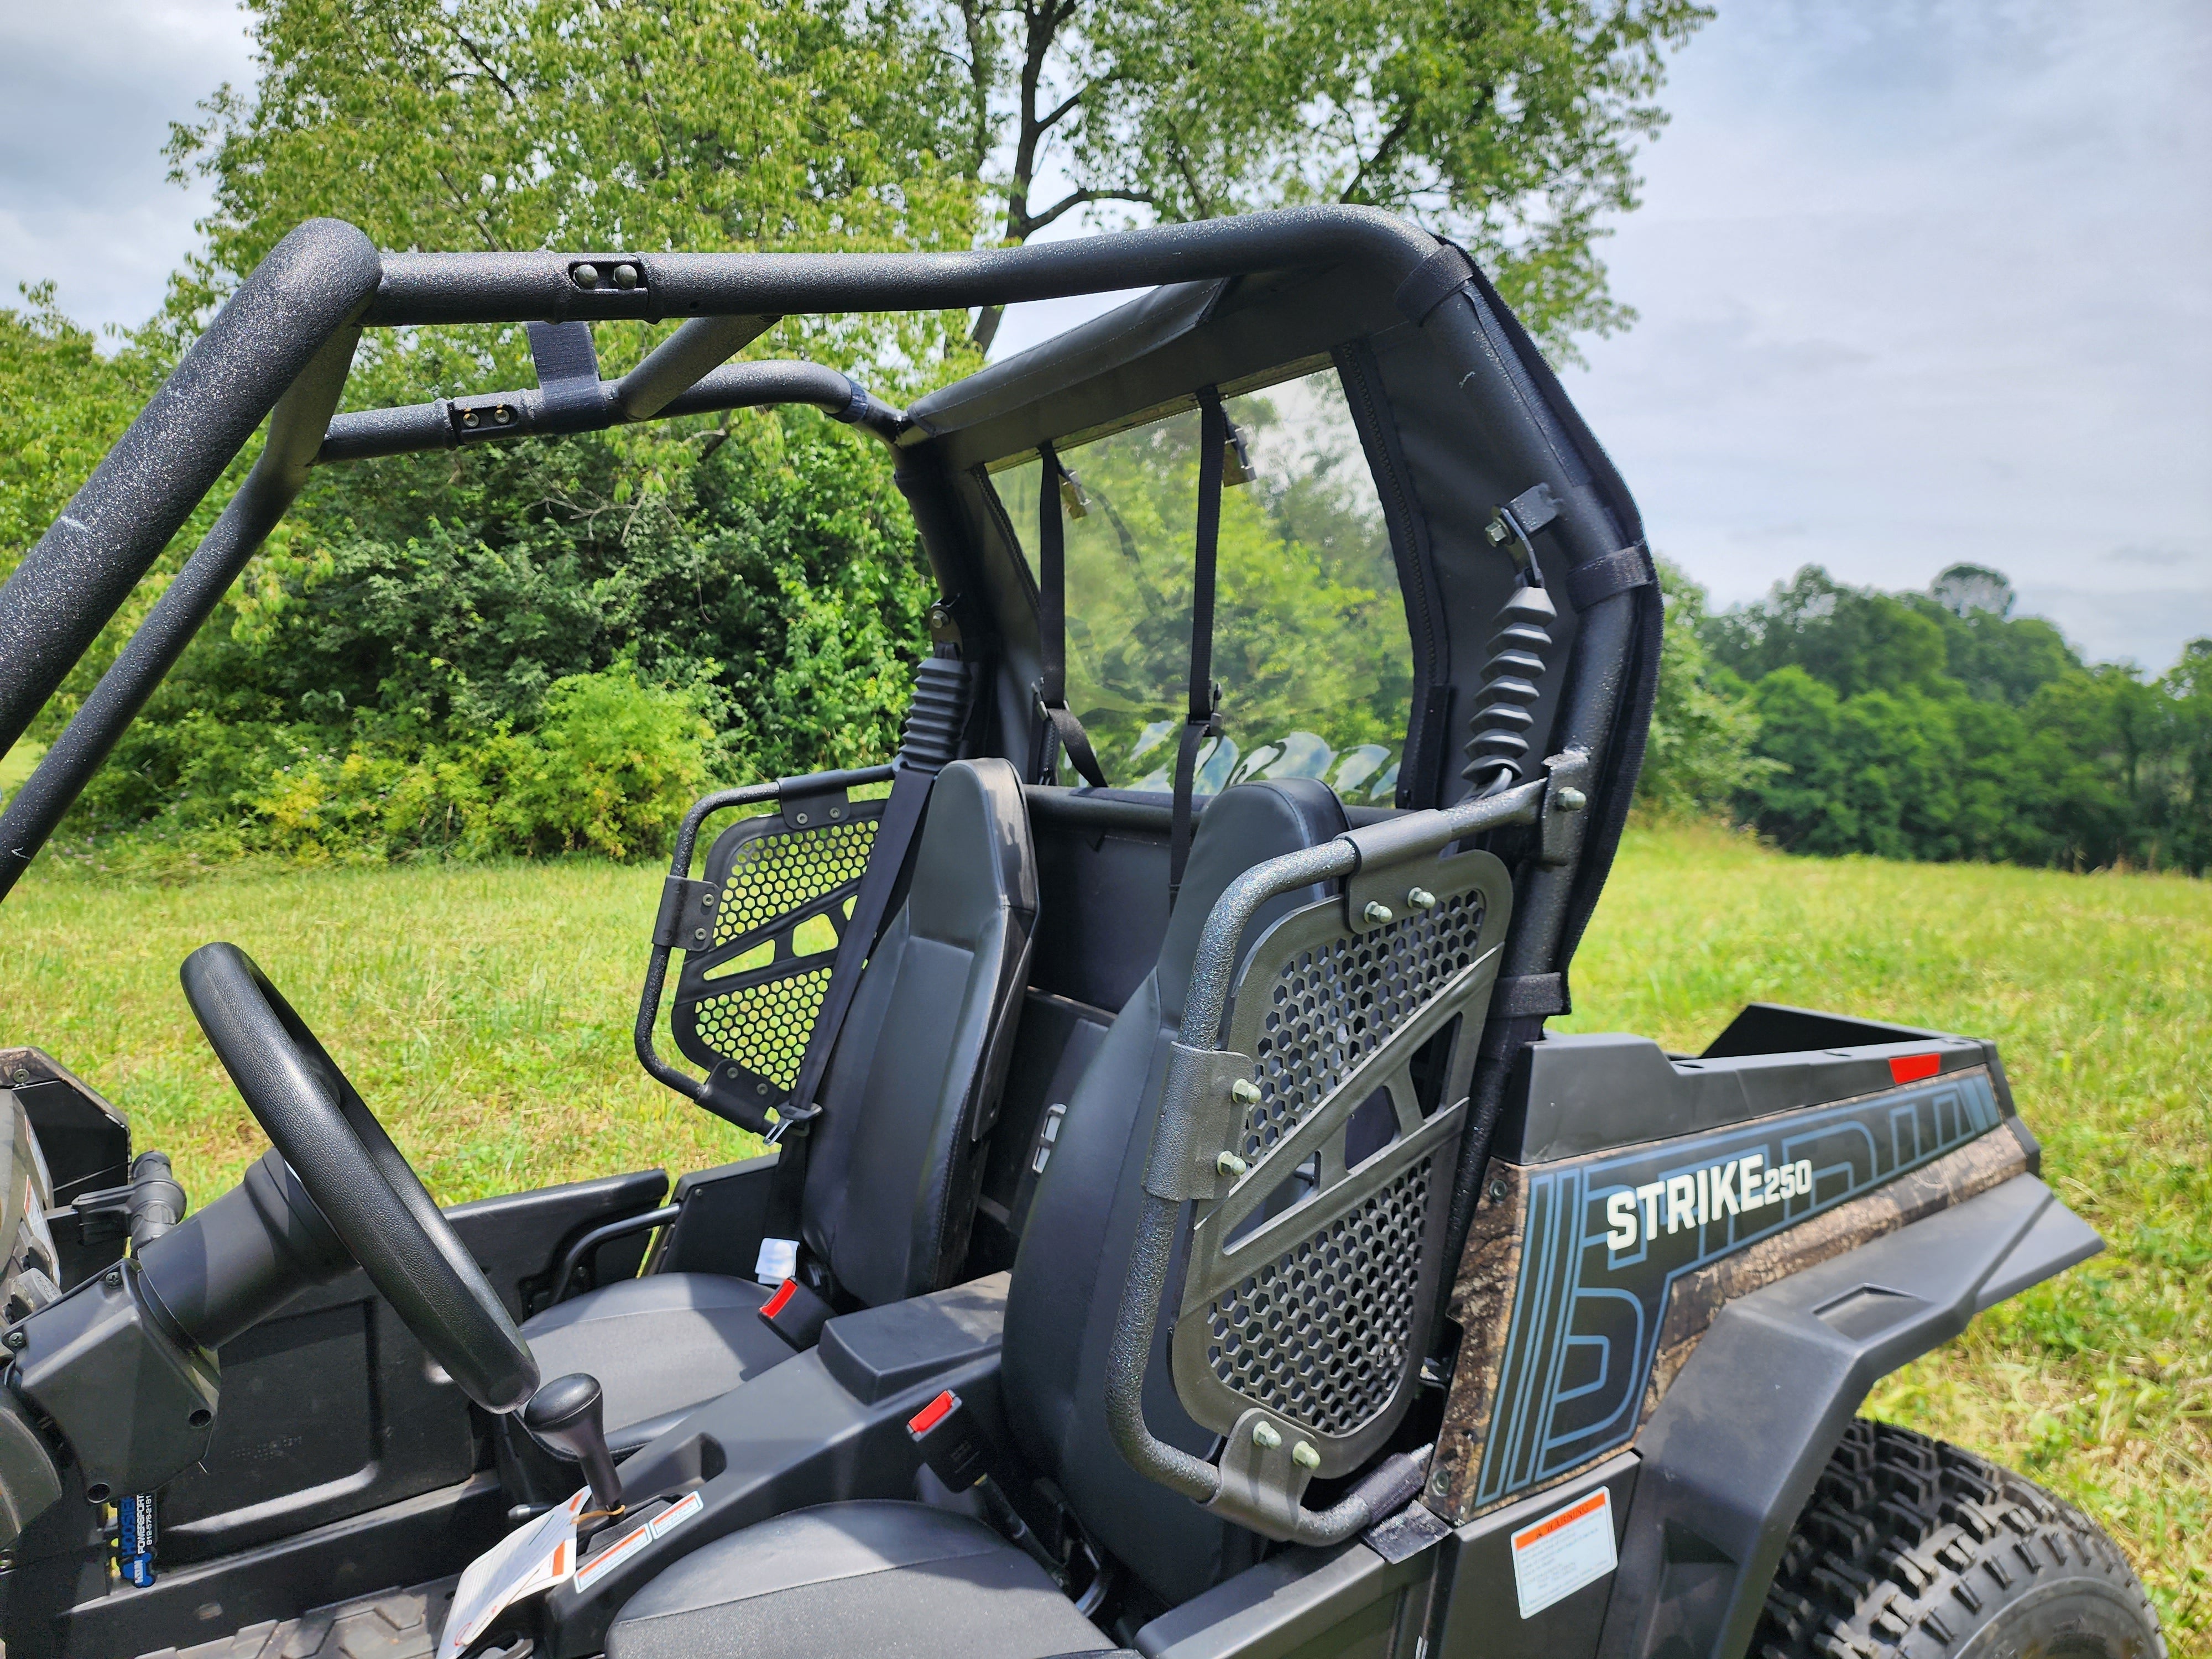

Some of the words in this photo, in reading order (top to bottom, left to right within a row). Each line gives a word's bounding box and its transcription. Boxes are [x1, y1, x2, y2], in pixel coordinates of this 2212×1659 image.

[1607, 1154, 1764, 1250] STRIKE
[1764, 1159, 1812, 1205] 250
[137, 1494, 145, 1554] POWERSPORT
